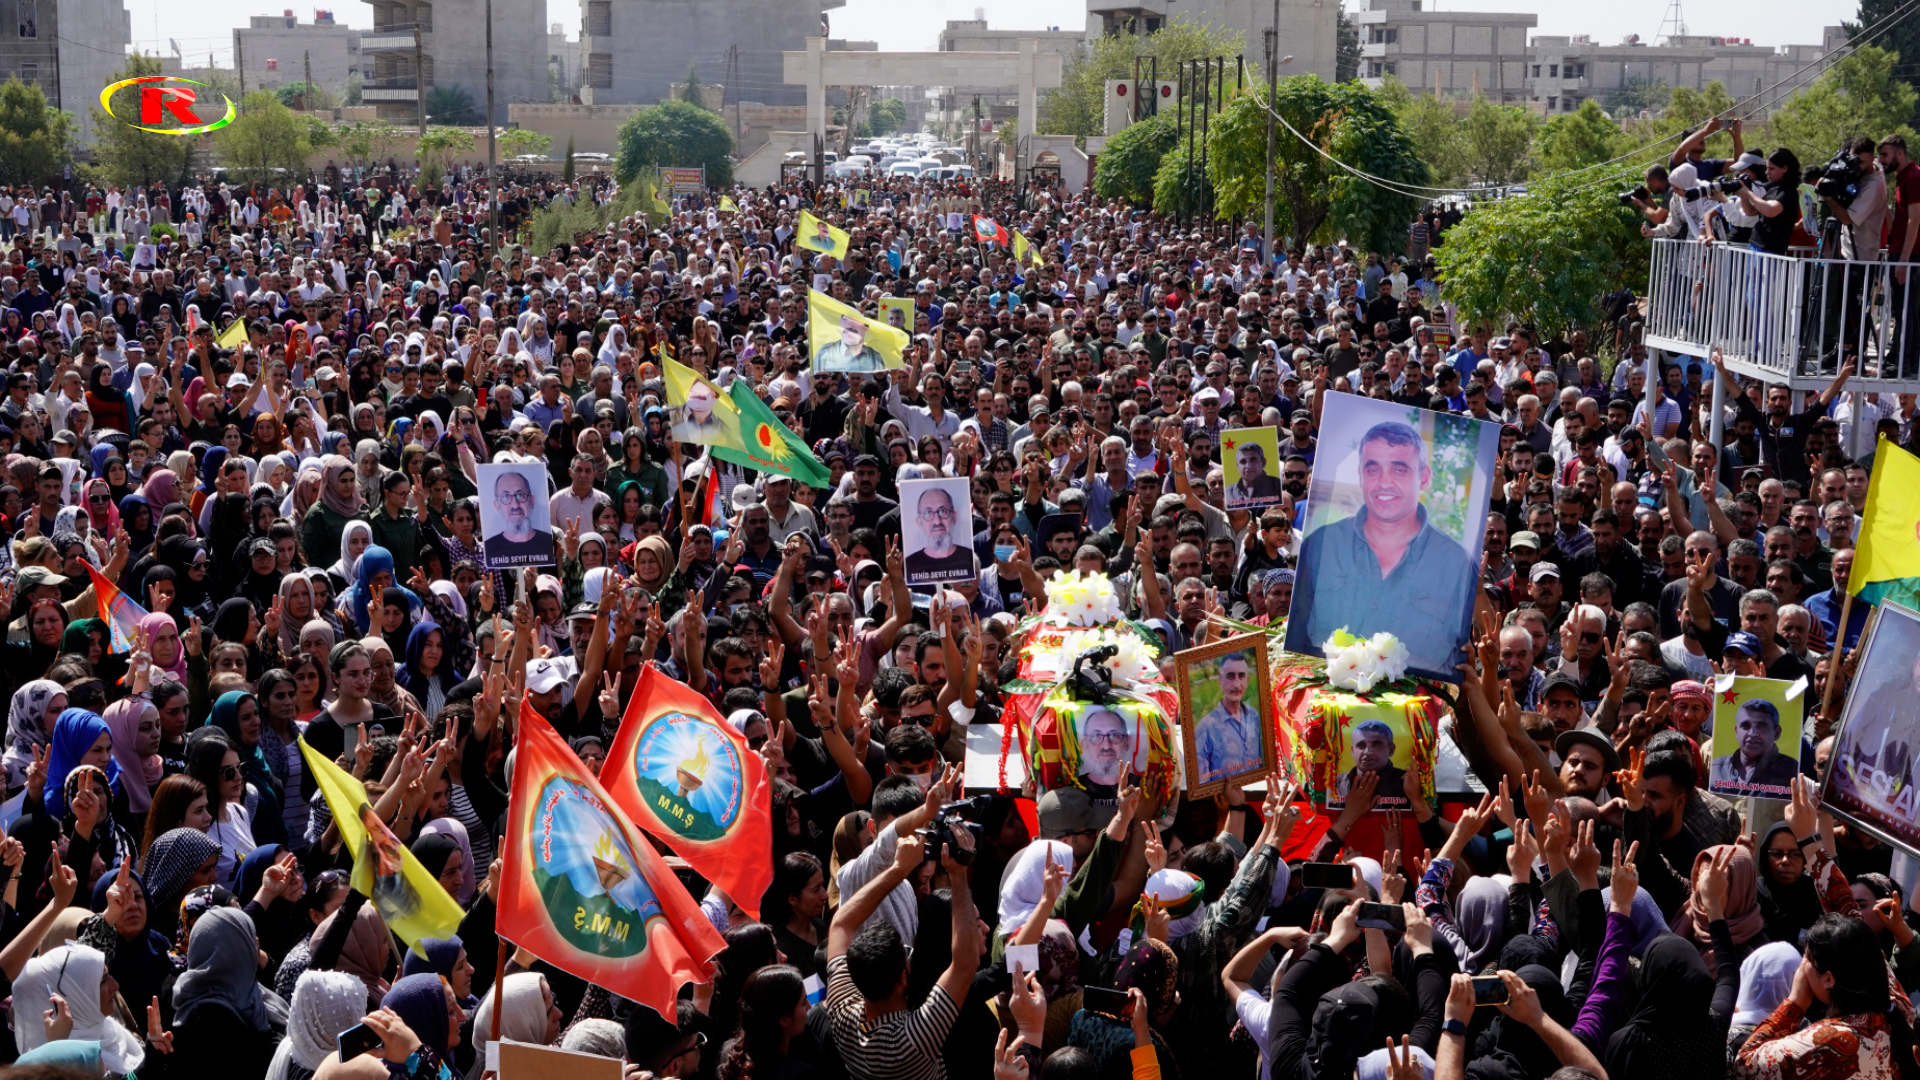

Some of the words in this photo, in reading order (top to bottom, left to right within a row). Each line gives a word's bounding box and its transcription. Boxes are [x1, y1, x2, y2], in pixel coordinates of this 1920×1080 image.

[748, 454, 776, 467] Kongra
[777, 463, 791, 472] Star
[528, 554, 549, 562] EVRAN
[948, 568, 968, 577] EVRAN
[1735, 782, 1759, 791] ASLAN
[1759, 784, 1792, 795] QAMIŞLO
